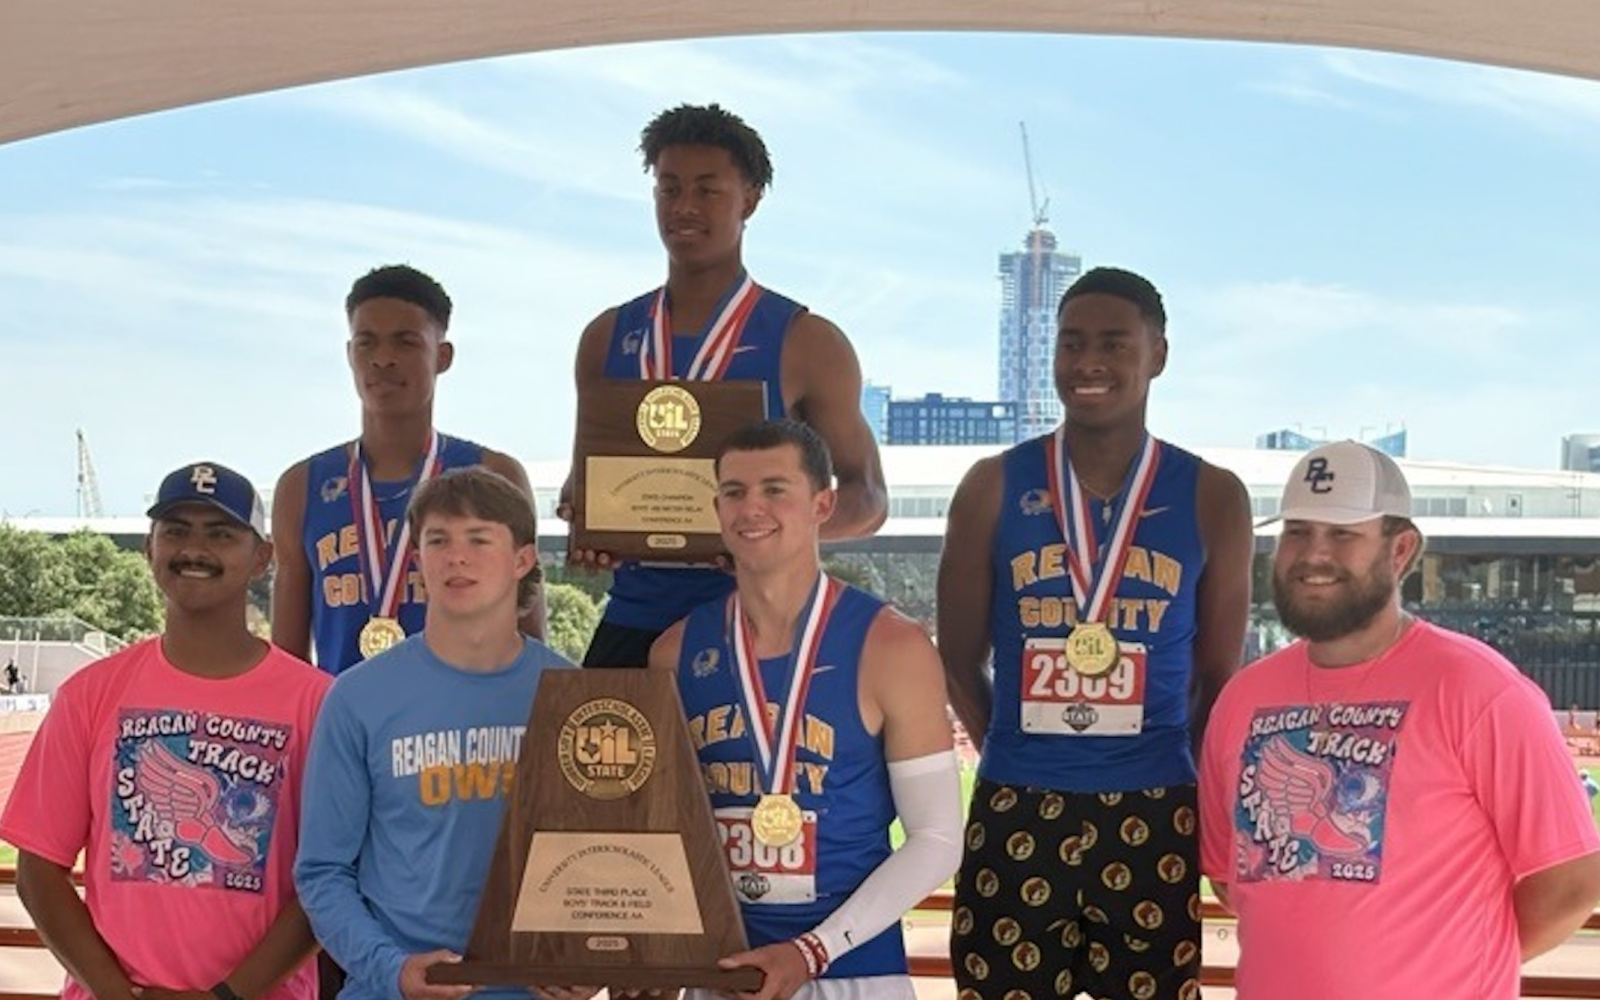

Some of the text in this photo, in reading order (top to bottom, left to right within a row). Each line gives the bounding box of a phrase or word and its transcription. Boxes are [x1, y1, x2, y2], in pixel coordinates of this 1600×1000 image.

[650, 401, 688, 429] UIL
[1010, 543, 1183, 597] REAN
[120, 714, 287, 749] REAGAN COUNTY
[1251, 705, 1403, 737] REAGAN COUNTY
[392, 725, 527, 778] REAGAN COUNT
[576, 720, 637, 764] UIL
[1307, 732, 1387, 764] TRACK
[188, 739, 277, 783] TRACK
[587, 764, 627, 777] STATE
[117, 767, 190, 877] STATE
[225, 873, 262, 890] 2025
[1332, 864, 1375, 880] 2025
[590, 900, 618, 908] TRACK
[594, 888, 618, 897] THIRD
[621, 888, 648, 897] PLACE
[571, 911, 628, 920] CONFERENCE
